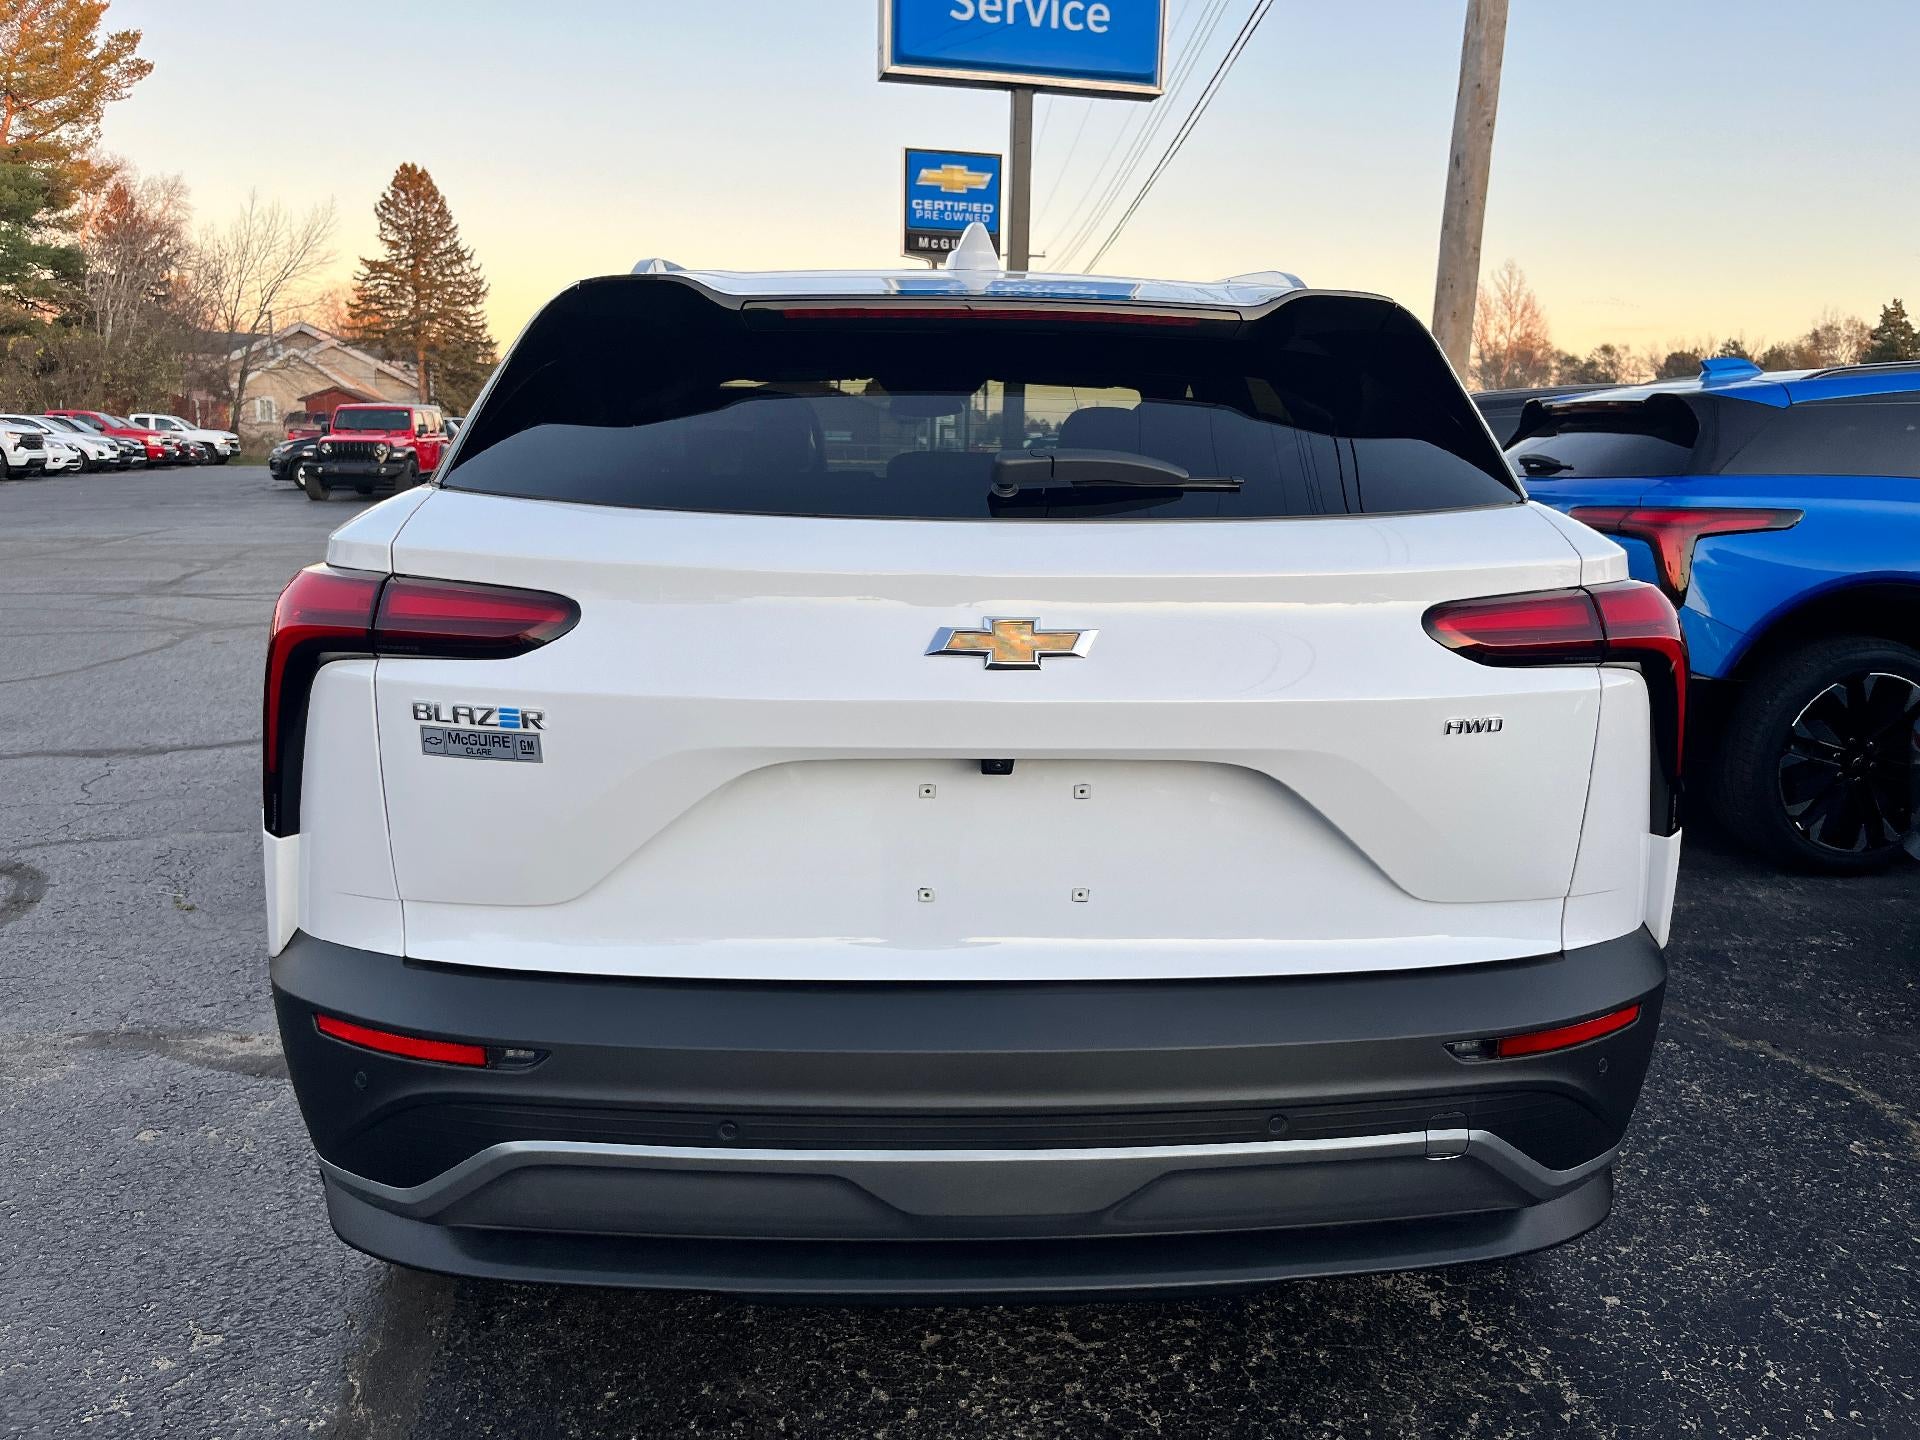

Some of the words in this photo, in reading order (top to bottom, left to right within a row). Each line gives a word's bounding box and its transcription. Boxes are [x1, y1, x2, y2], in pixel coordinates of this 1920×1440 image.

[950, 0, 1111, 33] Service
[911, 199, 994, 213] CERTIFIED
[915, 209, 991, 223] PRE-OWNED
[412, 701, 546, 730] BLAZER
[1443, 717, 1504, 736] AWD
[447, 732, 511, 749] McGUIRE
[519, 740, 535, 751] GM
[465, 747, 492, 756] CLARE
